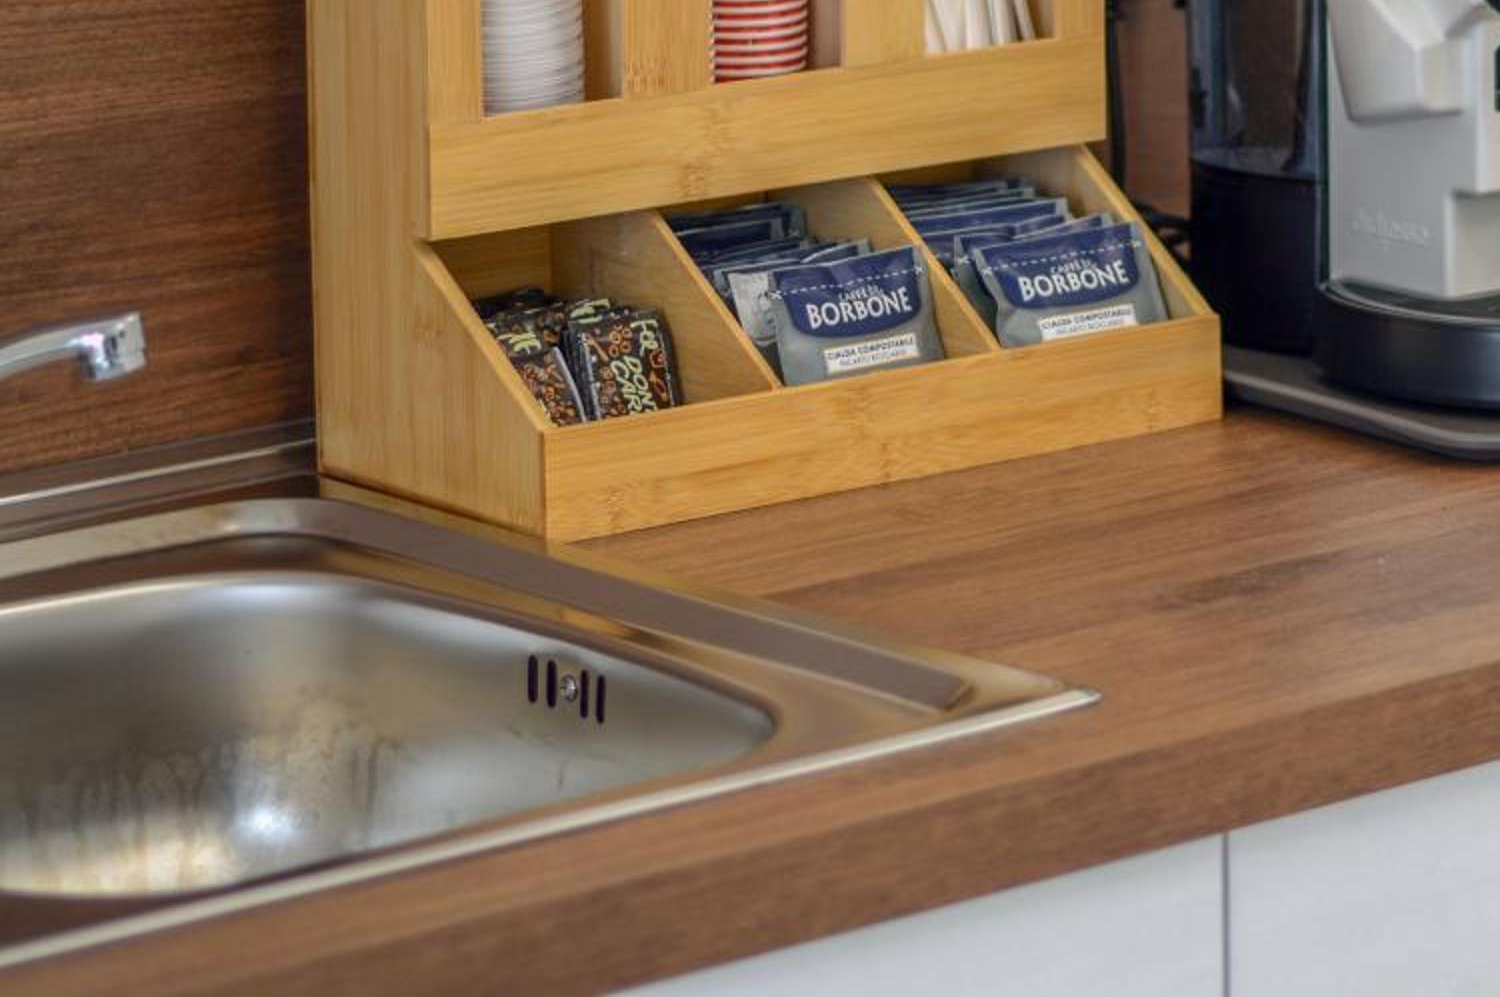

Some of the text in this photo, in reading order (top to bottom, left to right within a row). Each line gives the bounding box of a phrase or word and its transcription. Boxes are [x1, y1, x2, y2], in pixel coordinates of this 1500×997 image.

[1017, 259, 1130, 302] BORBONE
[805, 286, 913, 330] BORBONE
[610, 360, 642, 412] CAR
